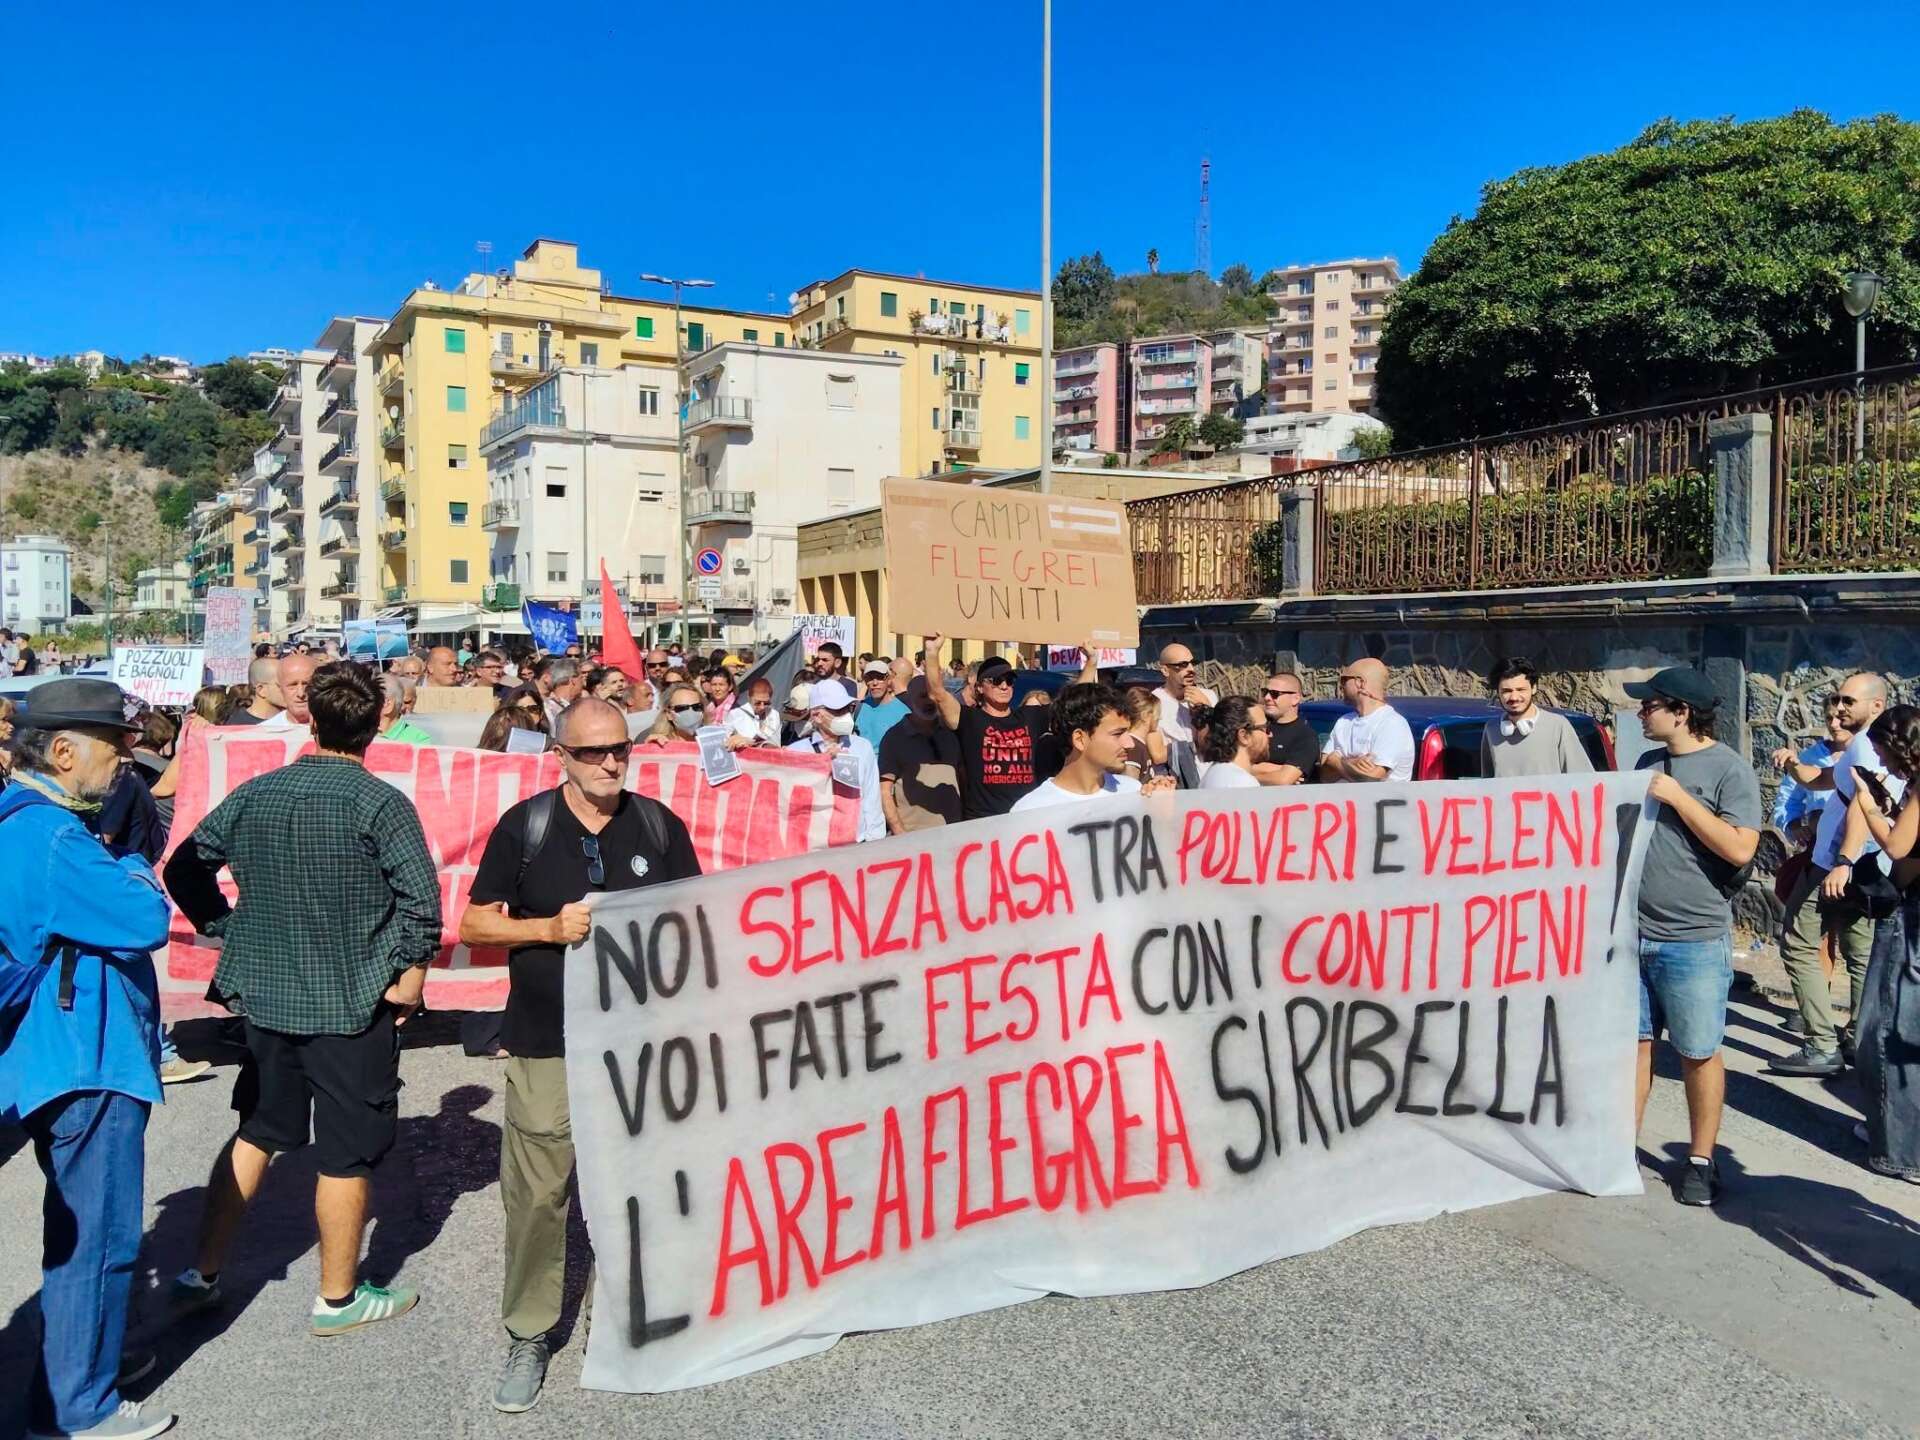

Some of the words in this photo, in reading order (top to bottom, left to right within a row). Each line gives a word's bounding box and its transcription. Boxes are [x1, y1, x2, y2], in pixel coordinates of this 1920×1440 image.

[950, 500, 1042, 543] CAMPI
[929, 544, 1099, 587] FLEGREI
[957, 583, 1061, 623] UNITI
[792, 615, 841, 629] MANFREDI
[812, 628, 846, 641] MELONI
[126, 649, 193, 667] POZZUOLI
[117, 664, 127, 678] E
[131, 664, 184, 680] BAGNOLI
[133, 679, 167, 691] UNITI
[153, 691, 193, 704] LOTTA
[985, 725, 1029, 739] CAMPI
[982, 748, 1032, 762] UNITI
[983, 764, 1002, 774] NO
[983, 774, 1022, 785] AMERICA'S
[594, 903, 718, 1012] NOI
[739, 851, 948, 978] SENZA
[954, 829, 1074, 934] CASA
[1068, 814, 1169, 903] TRA
[1176, 799, 1358, 886] POLVERI
[1372, 799, 1407, 875] E
[1416, 781, 1606, 877] VELENI
[603, 1032, 729, 1138] VOI
[750, 979, 902, 1100] FATE
[924, 932, 1123, 1060] FESTA
[1130, 917, 1234, 1016] CON
[1250, 914, 1264, 990] I
[1280, 901, 1441, 992] CONTI
[1462, 883, 1588, 990] PIENI
[919, 1038, 1199, 1241] FLEGREA
[1210, 1010, 1282, 1175] SI
[1284, 994, 1568, 1151] RIBELLA
